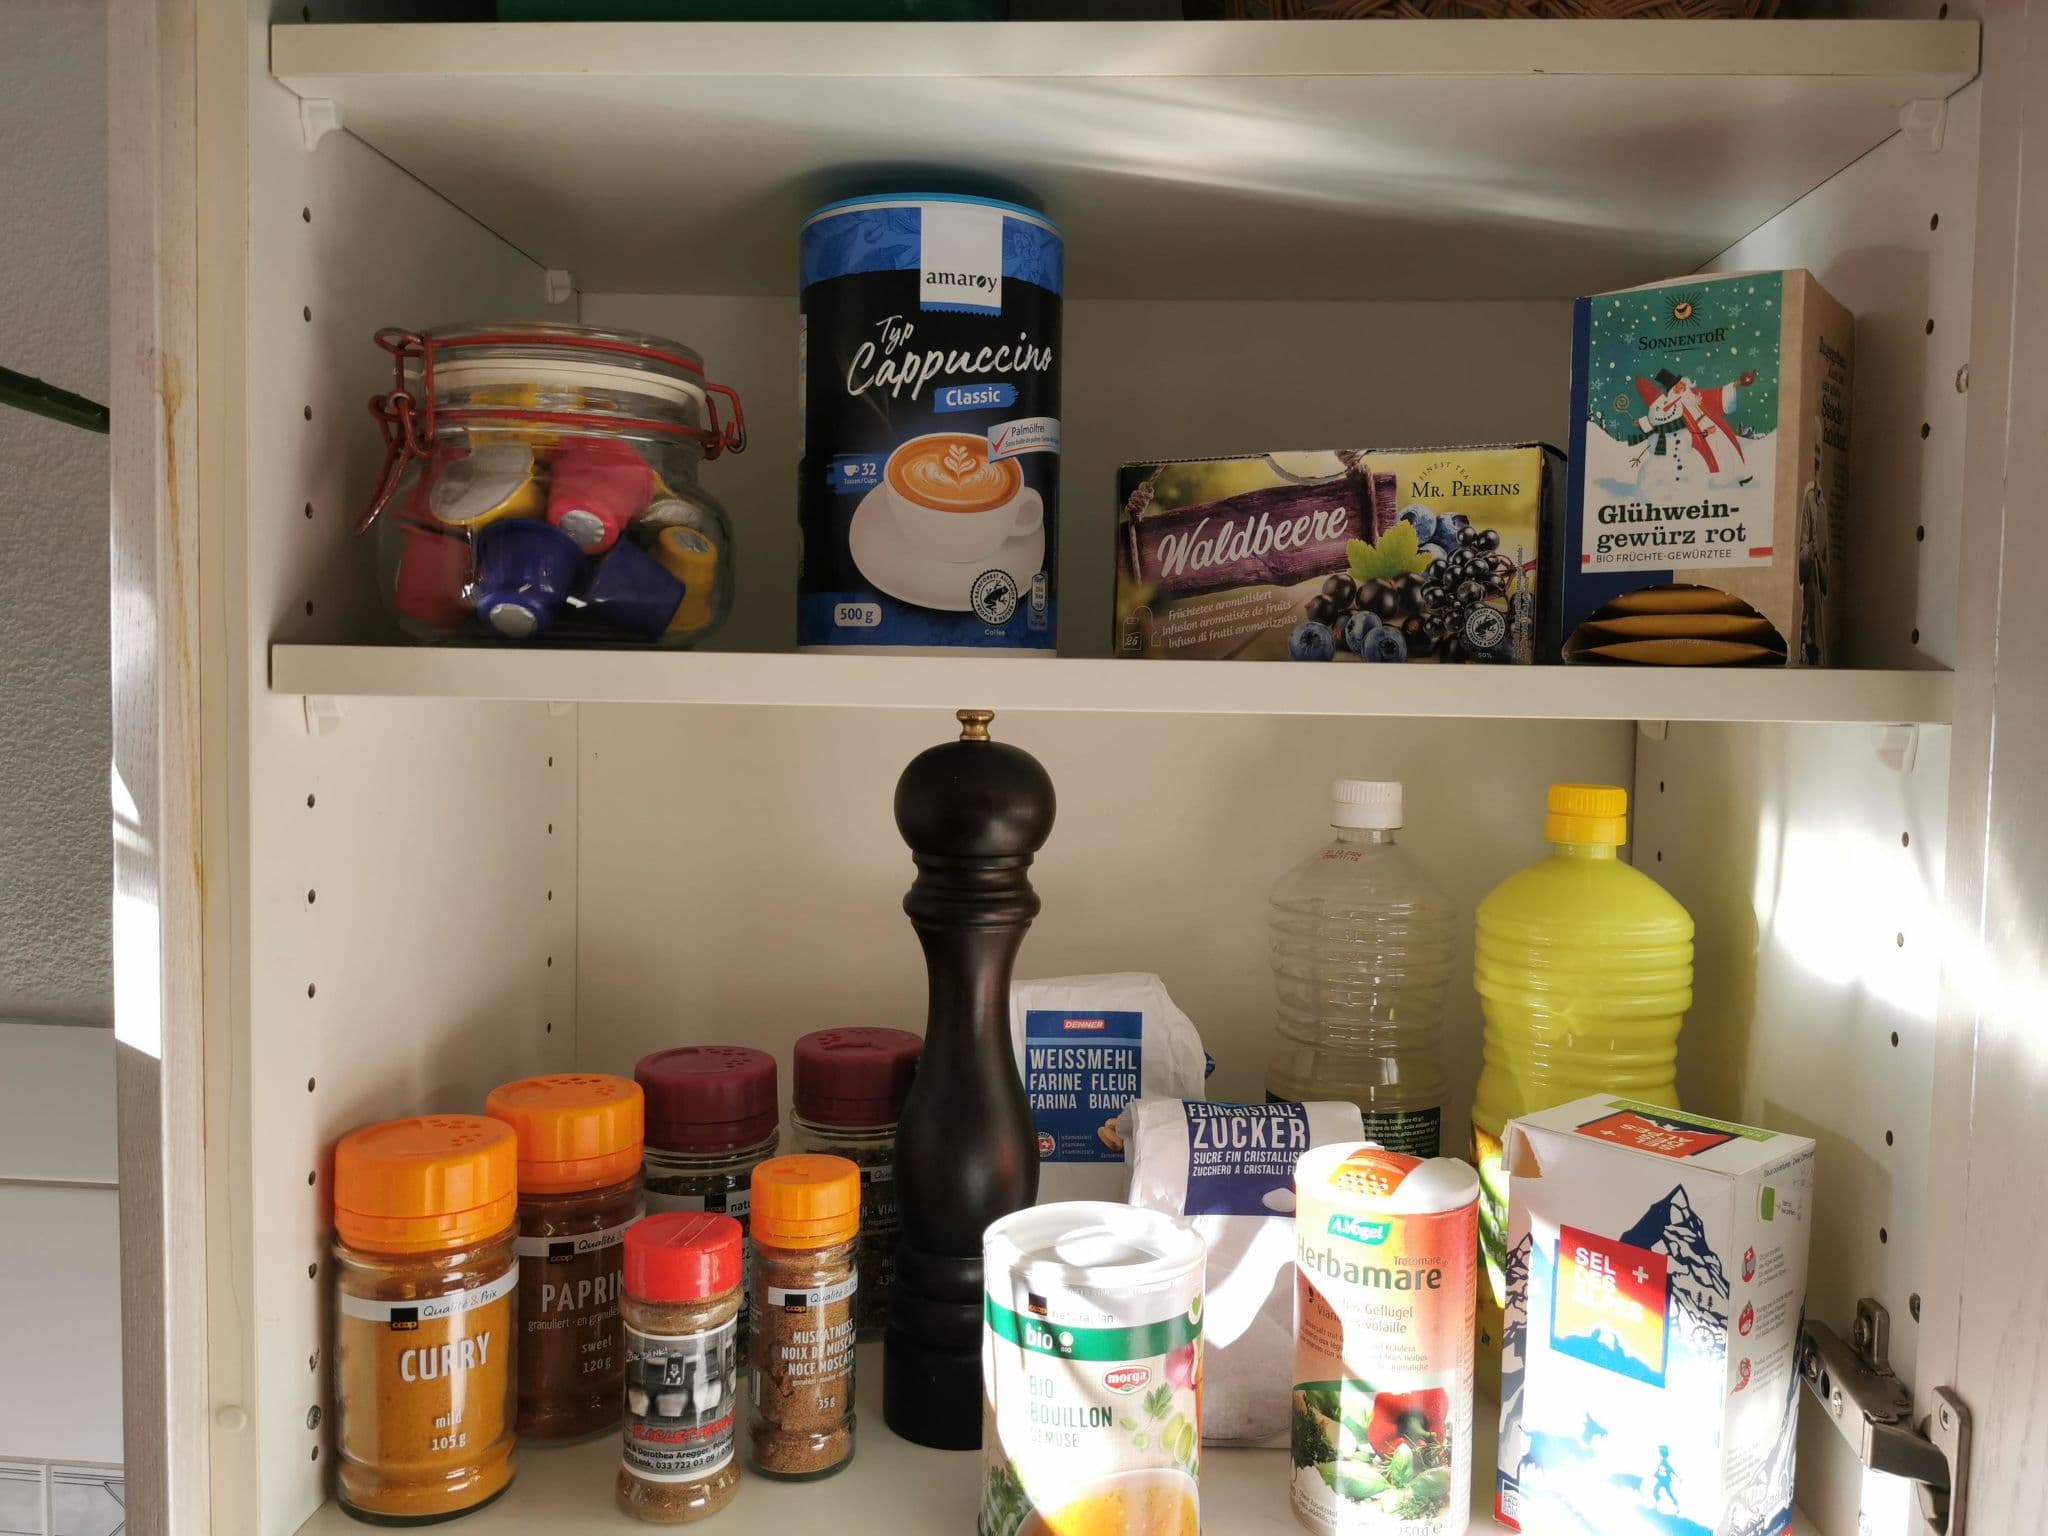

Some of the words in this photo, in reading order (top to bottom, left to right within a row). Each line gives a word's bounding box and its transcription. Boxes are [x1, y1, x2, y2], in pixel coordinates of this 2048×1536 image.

[926, 271, 997, 293] amaroy
[875, 314, 915, 356] Typ
[1638, 327, 1726, 350] SONNENTOR
[846, 331, 1052, 401] Cappuccino
[945, 386, 1001, 406] Classic
[1011, 424, 1045, 437] Palmölfrei
[861, 463, 877, 476] 32
[1419, 461, 1450, 480] FINEST
[1455, 464, 1469, 480] TEA
[1451, 480, 1520, 496] PERKINS
[1597, 499, 1740, 524] Glühwein-
[1157, 506, 1349, 578] Waldbeere
[1596, 525, 1695, 553] gewürz
[1705, 522, 1746, 544] rot
[1596, 554, 1614, 563] BIO
[840, 607, 863, 620] 500
[865, 608, 874, 624] g
[1167, 605, 1213, 621] Früchtetee
[1215, 590, 1272, 611] aromatisiert
[1162, 621, 1198, 637] Infusion
[1199, 610, 1250, 626] aromatisée
[1251, 606, 1264, 617] de
[1265, 600, 1292, 615] fruits
[1168, 636, 1196, 649] Infuso
[1198, 633, 1207, 643] di
[1209, 626, 1233, 642] frutti
[1235, 615, 1298, 635] aromatizzato
[1064, 1020, 1104, 1029] DENNER
[1030, 1048, 1137, 1070] WEISSMEHL
[1030, 1073, 1082, 1091] FARINE
[1091, 1073, 1137, 1091] FLEUR
[1030, 1093, 1077, 1110] FARINA
[1192, 1116, 1306, 1149] ZUCKER
[1193, 1151, 1222, 1164] SUCRE
[1225, 1150, 1242, 1163] FIN
[1192, 1165, 1231, 1177] ZUCCHERO
[1234, 1165, 1241, 1175] A
[1243, 1164, 1284, 1176] CRISTALLI
[550, 1255, 574, 1263] coop
[578, 1234, 616, 1251] Qualité
[1296, 1233, 1443, 1292] Herbamare
[1575, 1247, 1616, 1277] SEL
[392, 1320, 417, 1330] coop
[423, 1300, 468, 1317] Qualité
[470, 1295, 479, 1305] &
[480, 1289, 498, 1304] Prix
[785, 1305, 806, 1313] coop
[810, 1290, 843, 1304] Qualité
[1365, 1303, 1413, 1321] Geflügel
[528, 1317, 569, 1332] granuliert
[576, 1317, 587, 1327] en
[589, 1306, 618, 1326] granulé
[1317, 1303, 1339, 1322] Vian
[793, 1318, 854, 1345] MUSKATNUSS
[1026, 1321, 1053, 1350] bio
[1365, 1320, 1407, 1335] volaille
[582, 1333, 612, 1354] sweet
[781, 1346, 809, 1361] NOIX
[401, 1331, 490, 1382] CURRY
[582, 1360, 603, 1374] 120
[788, 1361, 816, 1376] NOCE
[1109, 1370, 1148, 1386] morga
[1029, 1375, 1055, 1399] BIO
[817, 1397, 829, 1410] 35
[1029, 1401, 1113, 1429] BOUILLON
[432, 1434, 456, 1451] 105
[638, 1447, 674, 1459] Dorothea
[676, 1447, 711, 1460] Aregger,
[675, 1461, 691, 1470] 722
[694, 1458, 704, 1467] 03
[705, 1454, 715, 1464] 09
